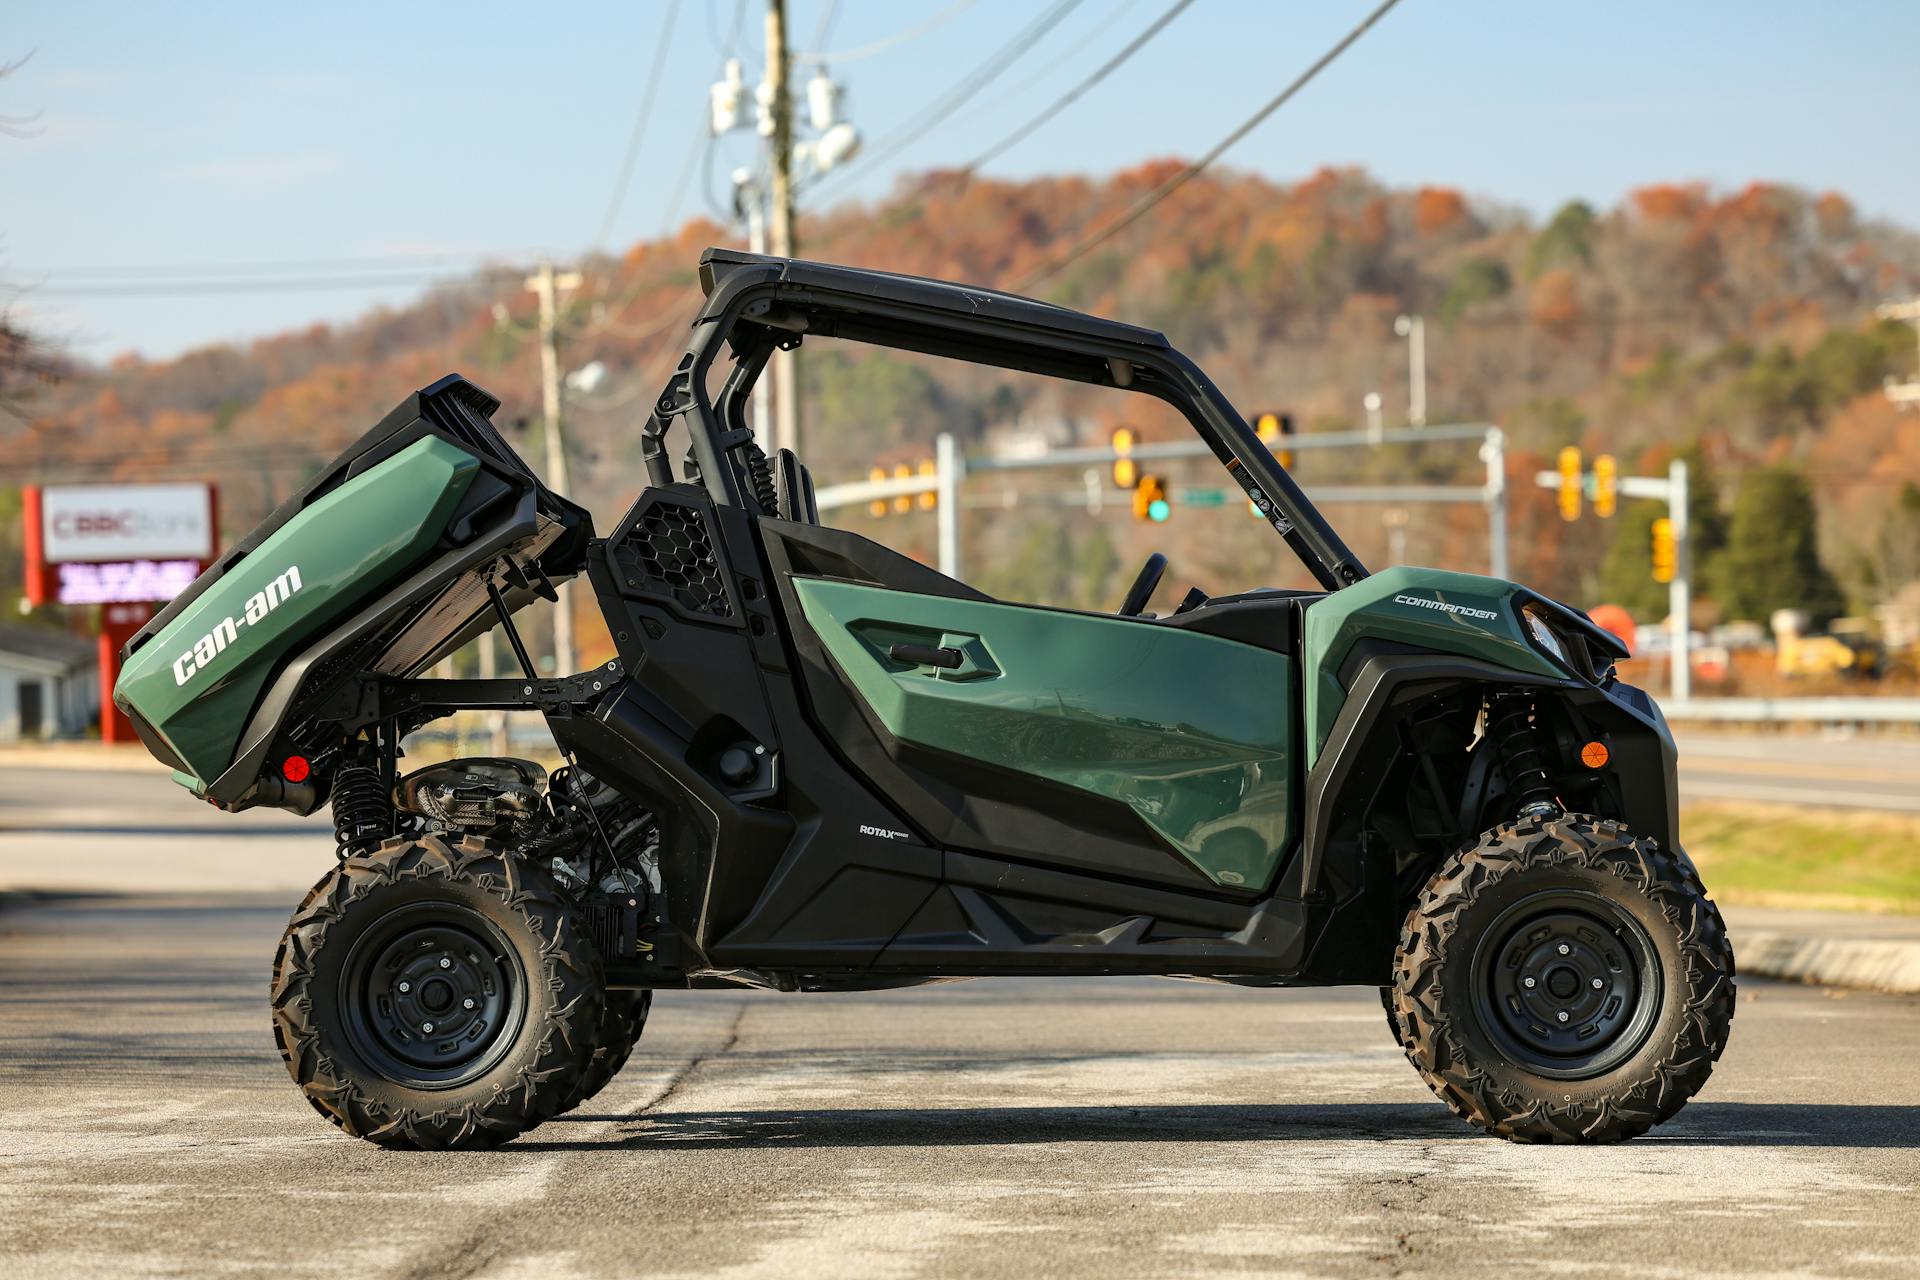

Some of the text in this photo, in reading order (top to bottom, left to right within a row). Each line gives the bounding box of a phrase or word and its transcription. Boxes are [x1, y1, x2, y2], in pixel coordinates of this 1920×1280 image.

[1393, 594, 1498, 621] COMMANDER
[173, 565, 303, 687] can-am
[860, 825, 894, 839] ROTAX
